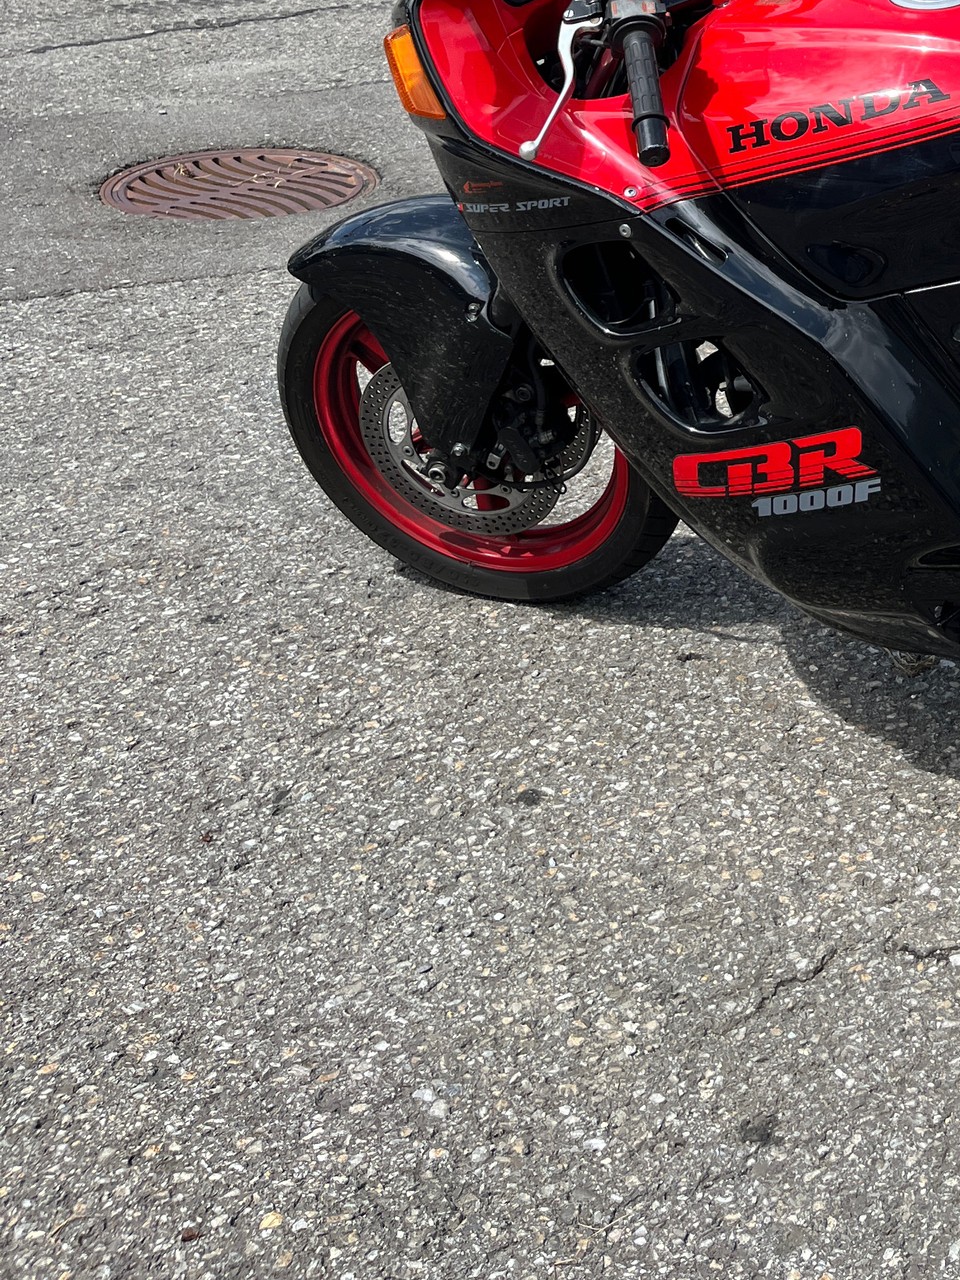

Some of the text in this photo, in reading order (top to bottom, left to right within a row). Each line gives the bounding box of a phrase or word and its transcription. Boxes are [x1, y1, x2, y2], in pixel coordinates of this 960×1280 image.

[726, 78, 951, 154] HONDA
[466, 196, 571, 213] SUPER SPORT
[672, 426, 878, 498] CBR
[751, 477, 882, 518] 1000F
